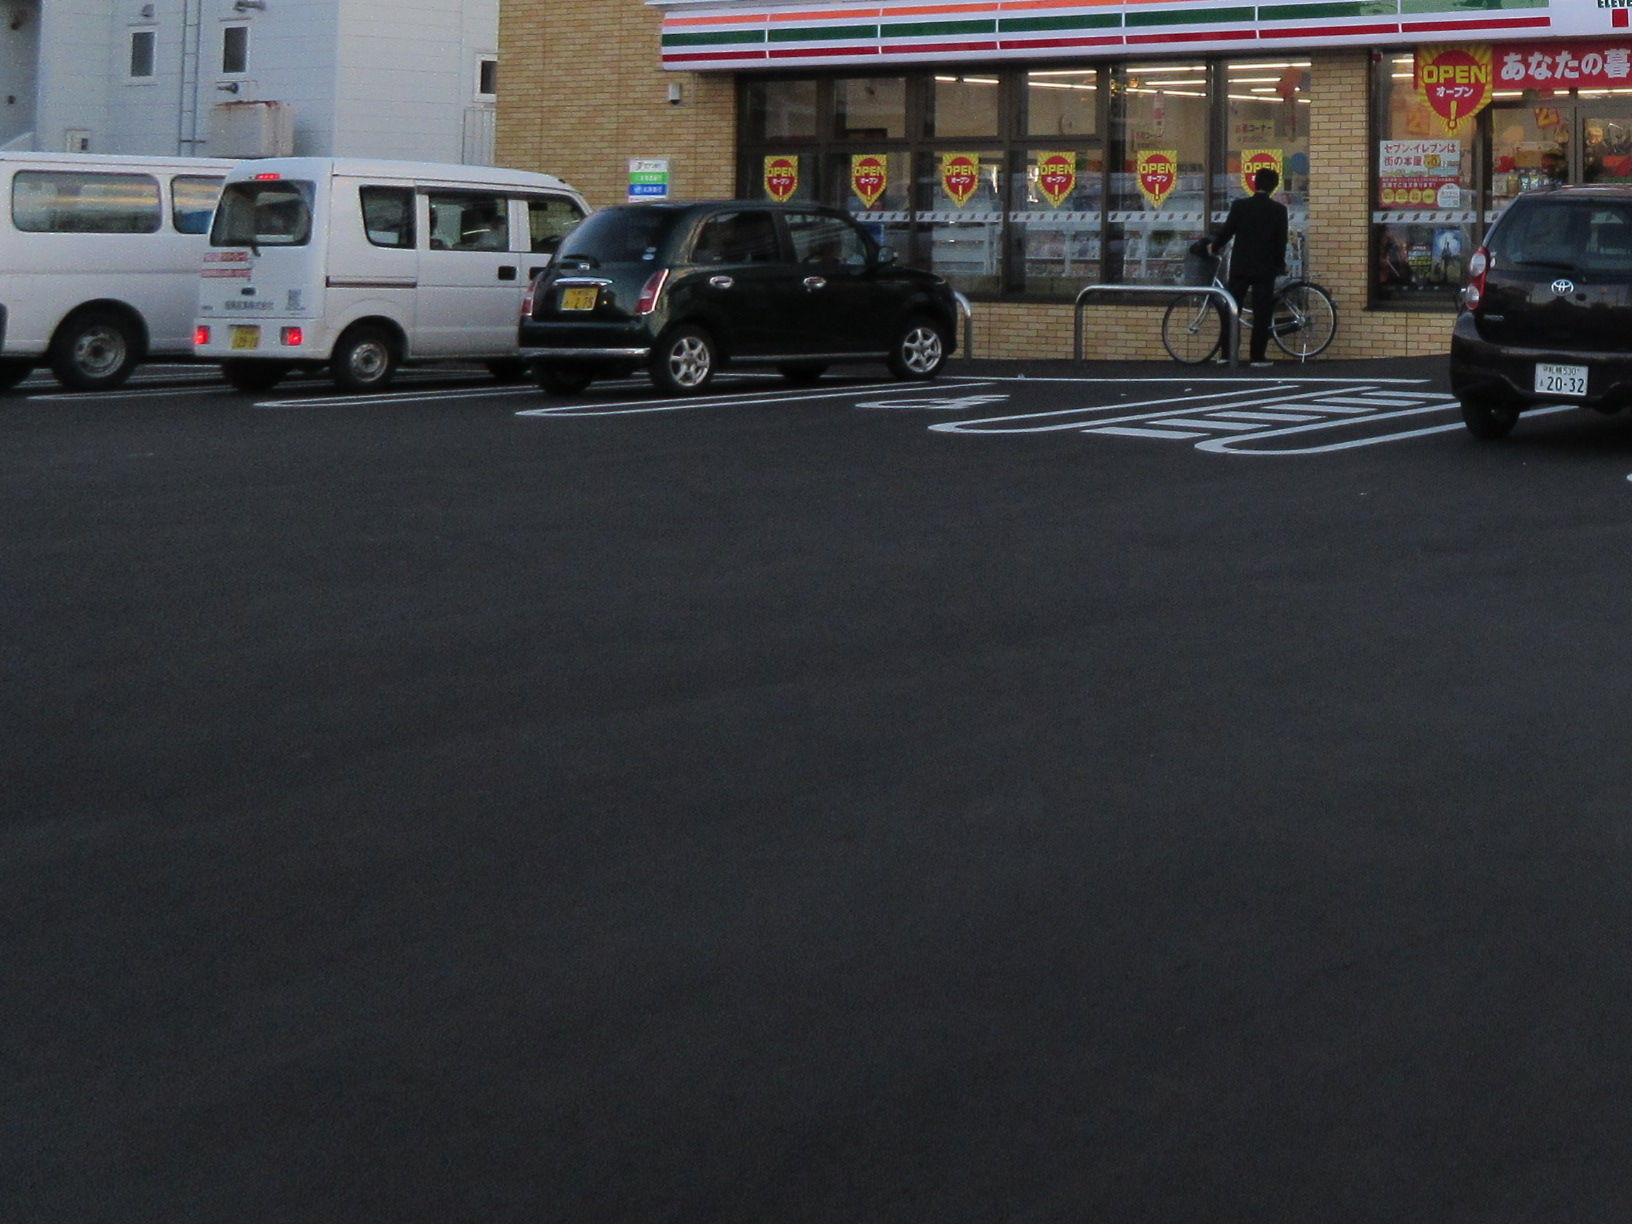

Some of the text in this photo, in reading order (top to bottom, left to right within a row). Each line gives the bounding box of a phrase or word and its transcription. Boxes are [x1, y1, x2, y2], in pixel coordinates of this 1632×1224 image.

[1423, 64, 1487, 84] OPEN
[1436, 86, 1473, 97] オープン
[945, 165, 976, 175] OPEN
[1040, 164, 1072, 175] OPEN
[1140, 163, 1174, 174] OPEN
[1547, 376, 1585, 393] 20-32
